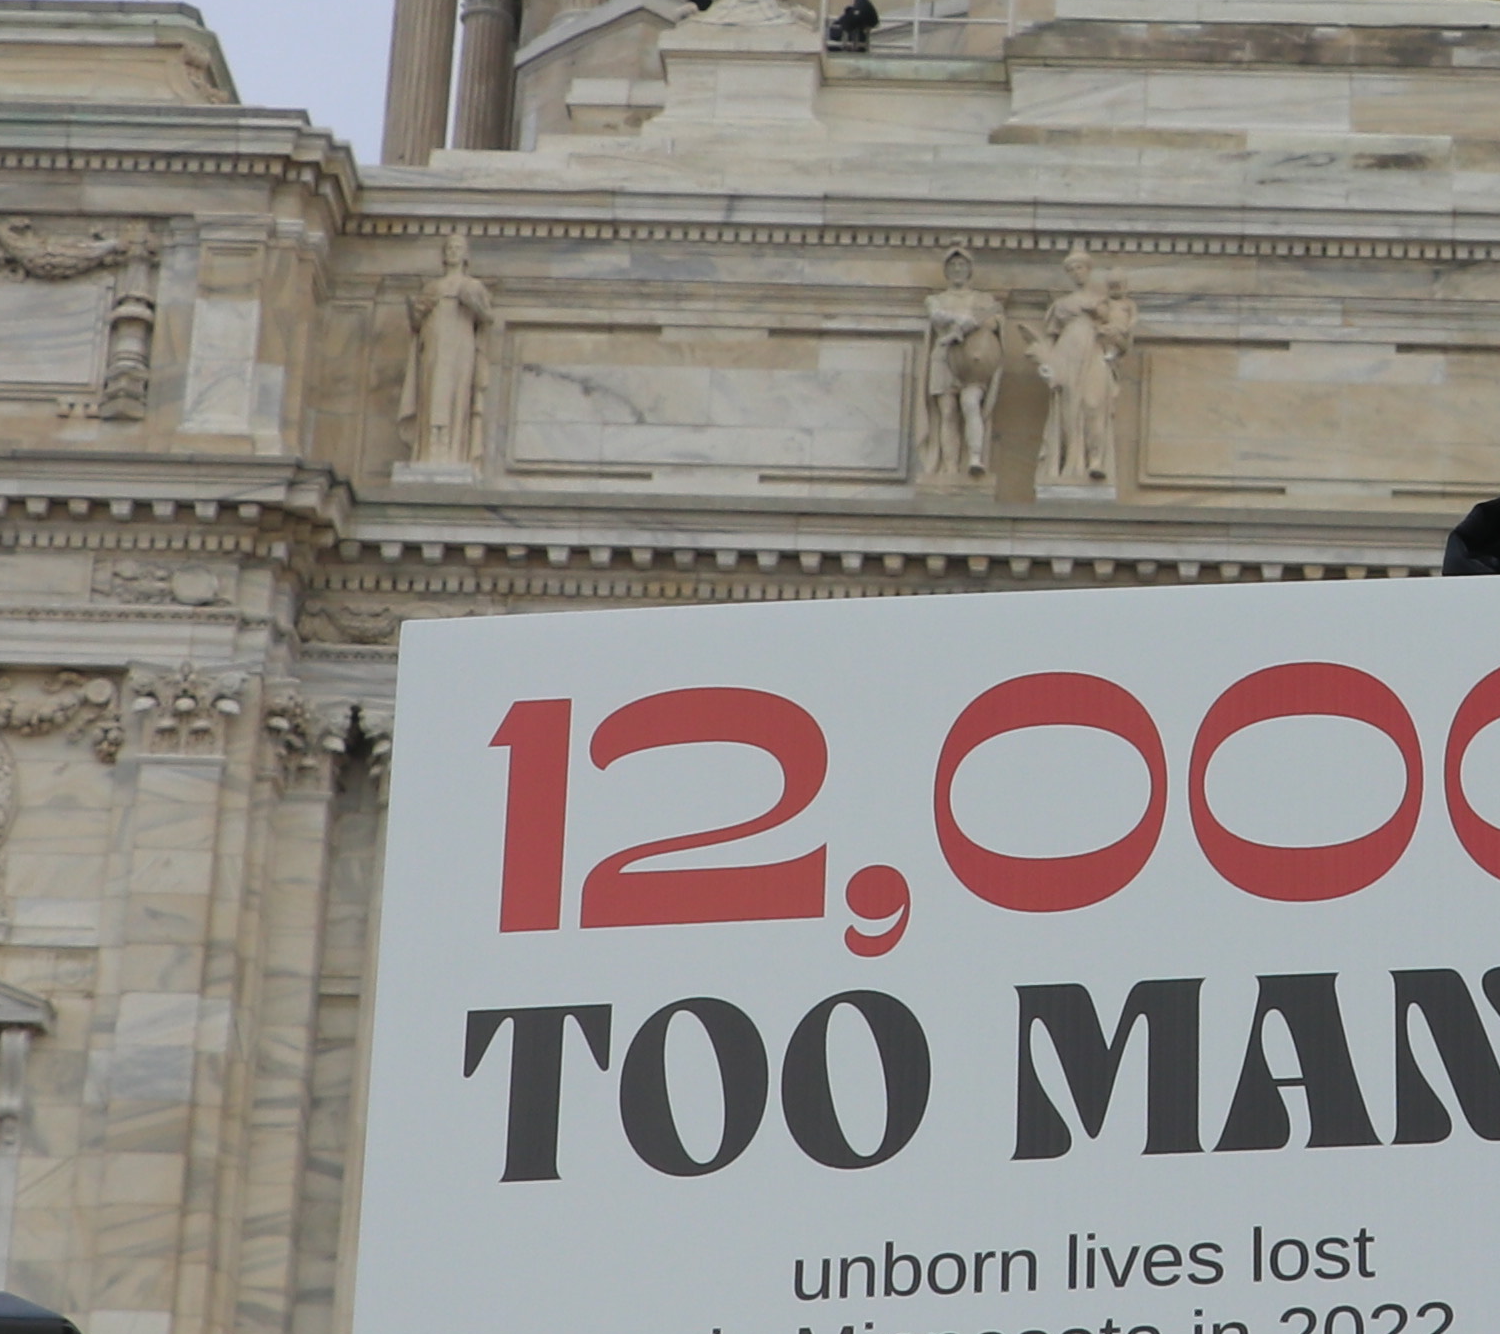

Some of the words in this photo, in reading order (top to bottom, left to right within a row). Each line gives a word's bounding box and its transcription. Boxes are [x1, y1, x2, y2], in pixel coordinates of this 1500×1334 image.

[463, 989, 932, 1183] TOO
[794, 1241, 1038, 1301] unborn
[1067, 1232, 1224, 1290] lives
[1252, 1225, 1376, 1282] lost
